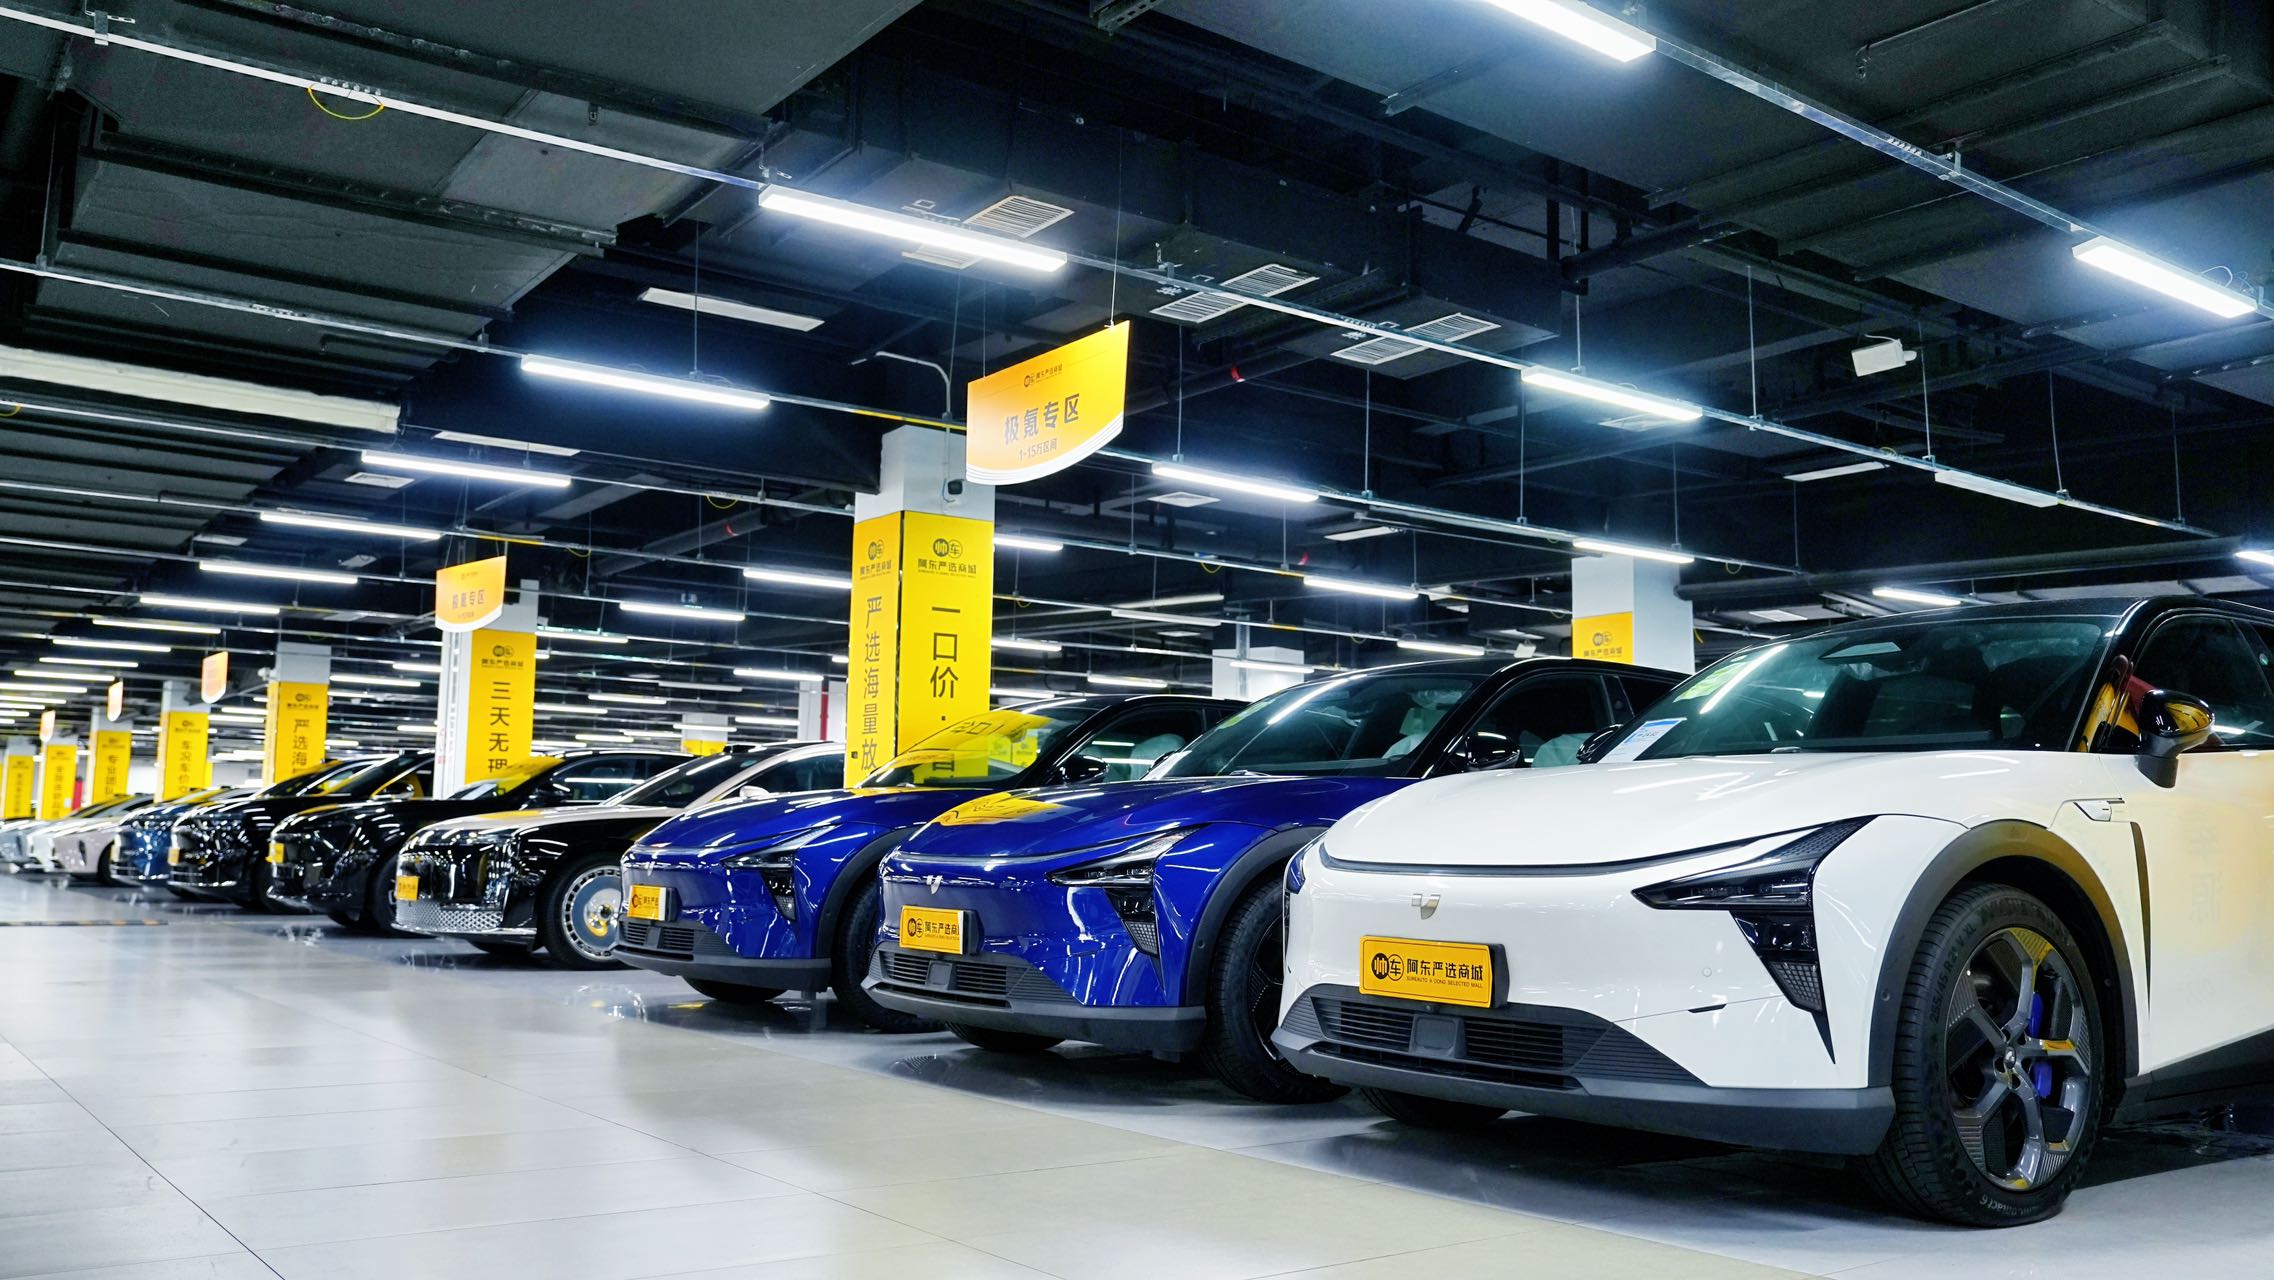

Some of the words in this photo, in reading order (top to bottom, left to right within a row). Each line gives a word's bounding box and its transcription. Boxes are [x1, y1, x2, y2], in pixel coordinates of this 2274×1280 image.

[1004, 393, 1080, 445] 极氪专区
[292, 718, 310, 773] 严选海
[1406, 958, 1484, 981] 阿东严选商城
